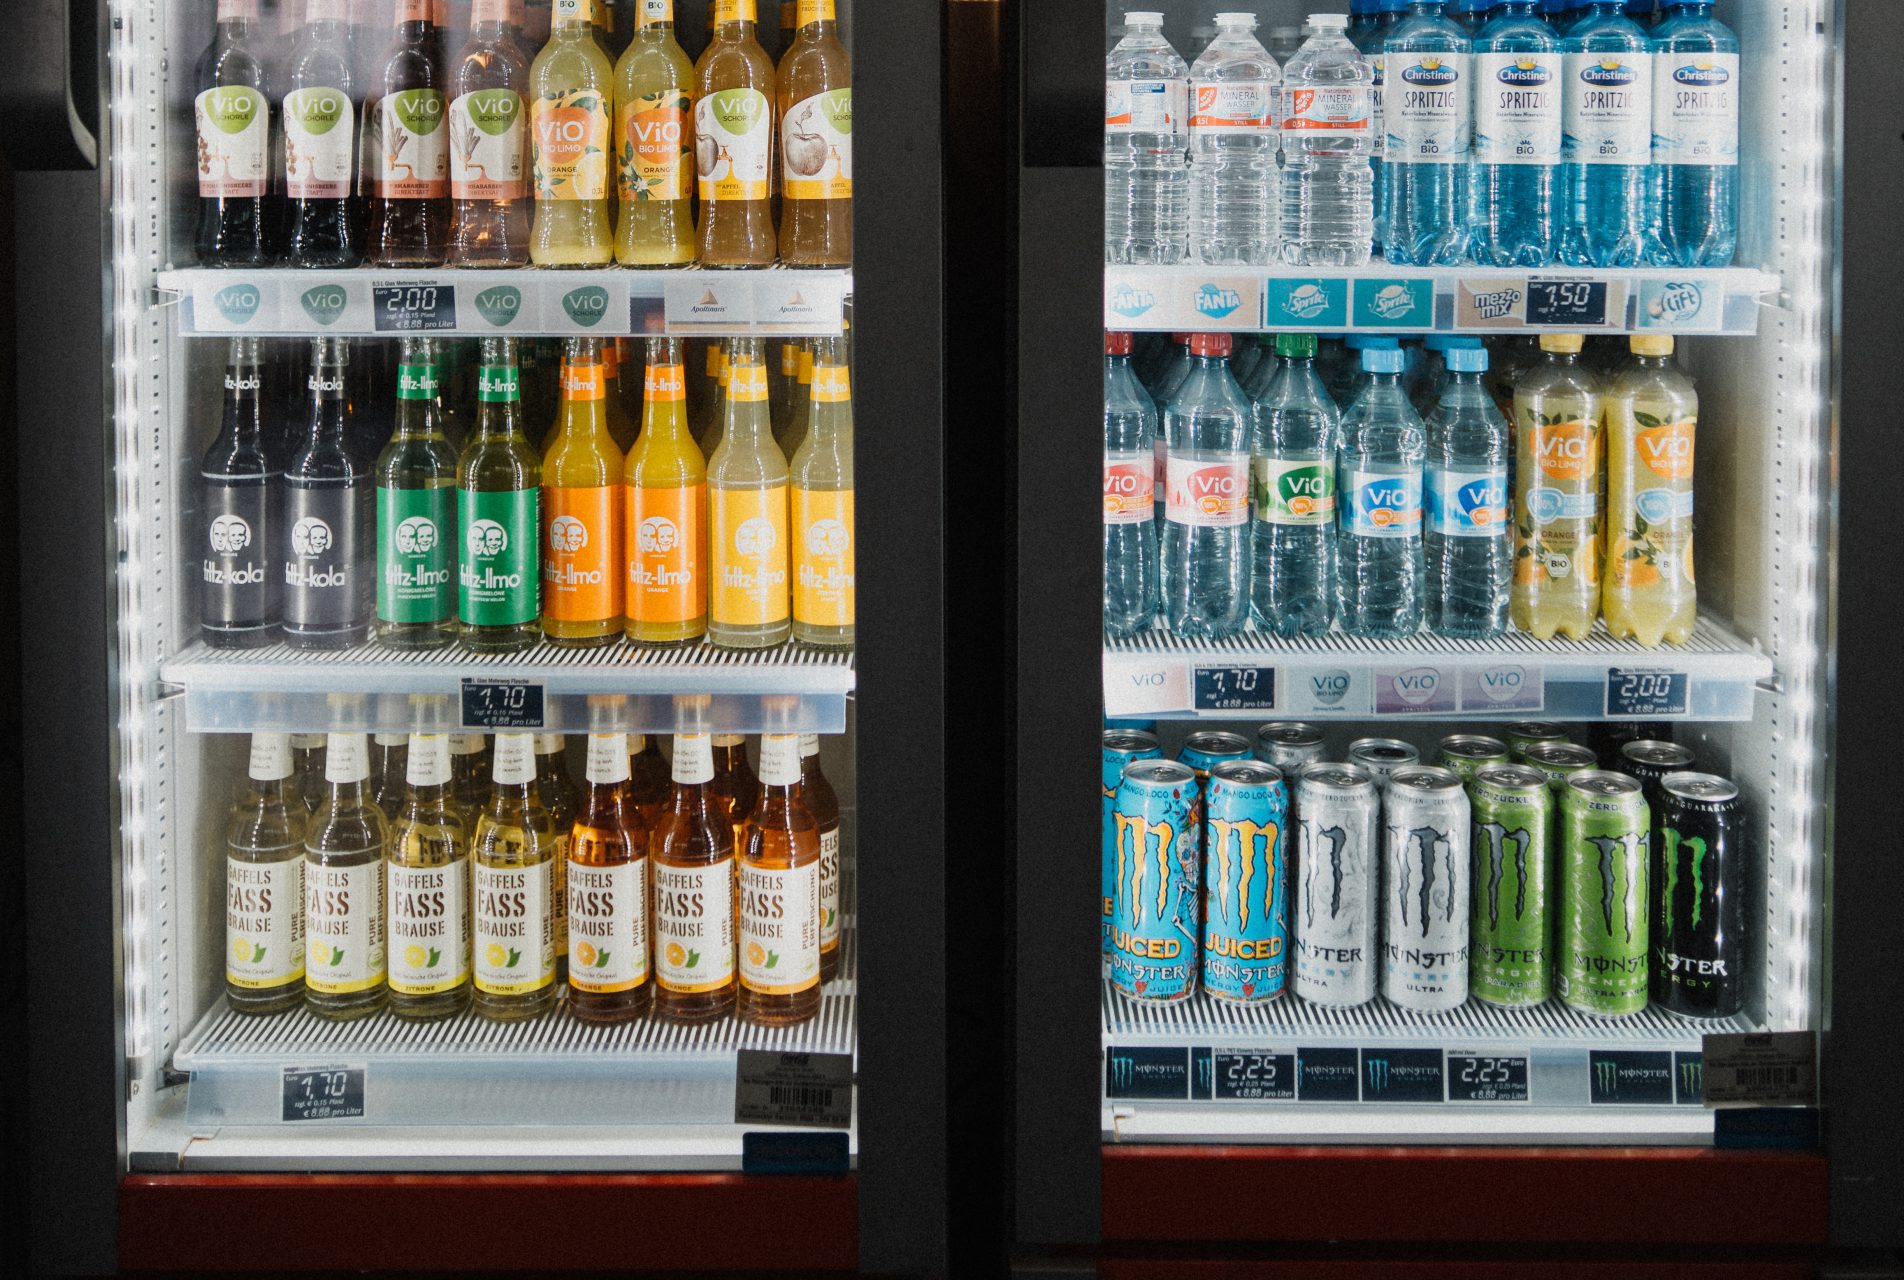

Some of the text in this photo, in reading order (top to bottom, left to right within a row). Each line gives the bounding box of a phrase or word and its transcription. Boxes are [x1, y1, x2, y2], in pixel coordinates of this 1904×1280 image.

[1402, 68, 1457, 82] Christinen
[1499, 69, 1551, 82] Christinen
[1582, 69, 1637, 82] Christinen
[1674, 69, 1729, 82] Christinen
[1221, 91, 1259, 100] MINERAL
[1318, 94, 1356, 103] MINERAL
[1404, 91, 1455, 108] SPRITZIG
[212, 96, 250, 113] ViO
[300, 97, 337, 114] ViO
[403, 98, 440, 114] ViO
[476, 98, 513, 114] ViO
[718, 98, 755, 114] ViO
[538, 120, 585, 142] ViO
[633, 121, 681, 142] ViO
[307, 293, 344, 307] ViO
[387, 288, 437, 312] 2,00
[481, 294, 517, 308] ViO
[569, 295, 604, 309] ViO
[1195, 292, 1242, 310] FANTA
[1291, 292, 1327, 311] Sprite
[1378, 294, 1414, 312] Sprite
[1475, 289, 1521, 307] mezzo
[1545, 283, 1591, 306] 1,50
[690, 305, 727, 313] Apollinaris
[779, 305, 815, 313] Apollinaris
[1480, 301, 1511, 319] mix
[1540, 436, 1586, 458] ViO
[1645, 435, 1691, 457] ViO
[1196, 475, 1234, 493] ViO
[1287, 476, 1325, 494] ViO
[1368, 488, 1407, 505] ViO
[1469, 486, 1503, 505] ViO
[1542, 531, 1577, 539] ORANGE
[203, 560, 264, 586] fritz-kola
[285, 561, 345, 588] fritz-kola
[386, 564, 449, 587] fritz-limo
[460, 564, 520, 589] fritz-limo
[630, 561, 692, 586] fritz-limo
[1130, 673, 1166, 687] ViO
[1213, 670, 1257, 693] 1,70
[1313, 676, 1348, 690] ViO
[1399, 675, 1435, 689] ViO
[1484, 671, 1520, 686] ViO
[1621, 675, 1671, 698] 2,00
[480, 686, 525, 709] 1,70
[1146, 789, 1169, 799] LOCO
[1222, 787, 1273, 800] MANGO LOCO
[1588, 801, 1620, 811] ZERO
[395, 873, 444, 889] GAFFELS
[478, 872, 525, 889] GAFFELS
[569, 869, 613, 888] GAFFELS
[657, 870, 703, 890] GAFFELS
[740, 868, 784, 890] GAFFELS
[395, 888, 445, 918] FASS
[478, 888, 526, 918] FASS
[570, 888, 614, 917] FASS
[657, 889, 704, 917] FASS
[740, 890, 784, 919] FASS
[369, 916, 377, 946] PURE
[395, 920, 445, 937] BRAUSE
[478, 920, 525, 937] BRAUSE
[570, 920, 614, 937] BRAUSE
[658, 919, 704, 937] BRAUSE
[741, 919, 784, 939] BRAUSE
[1204, 932, 1283, 960] JUICED
[1574, 952, 1649, 975] MONST
[1406, 984, 1445, 993] ULTRA
[1135, 1064, 1184, 1074] MONSTER
[1228, 1056, 1276, 1080] 2,25
[1305, 1065, 1355, 1075] MONSTER
[1390, 1066, 1440, 1076] MONSTER
[1461, 1059, 1509, 1084] 2,25
[1619, 1067, 1669, 1079] MONSTER
[301, 1072, 348, 1100] 1,70
[1264, 1091, 1277, 1099] pro
[332, 1107, 362, 1118] pro Liter
